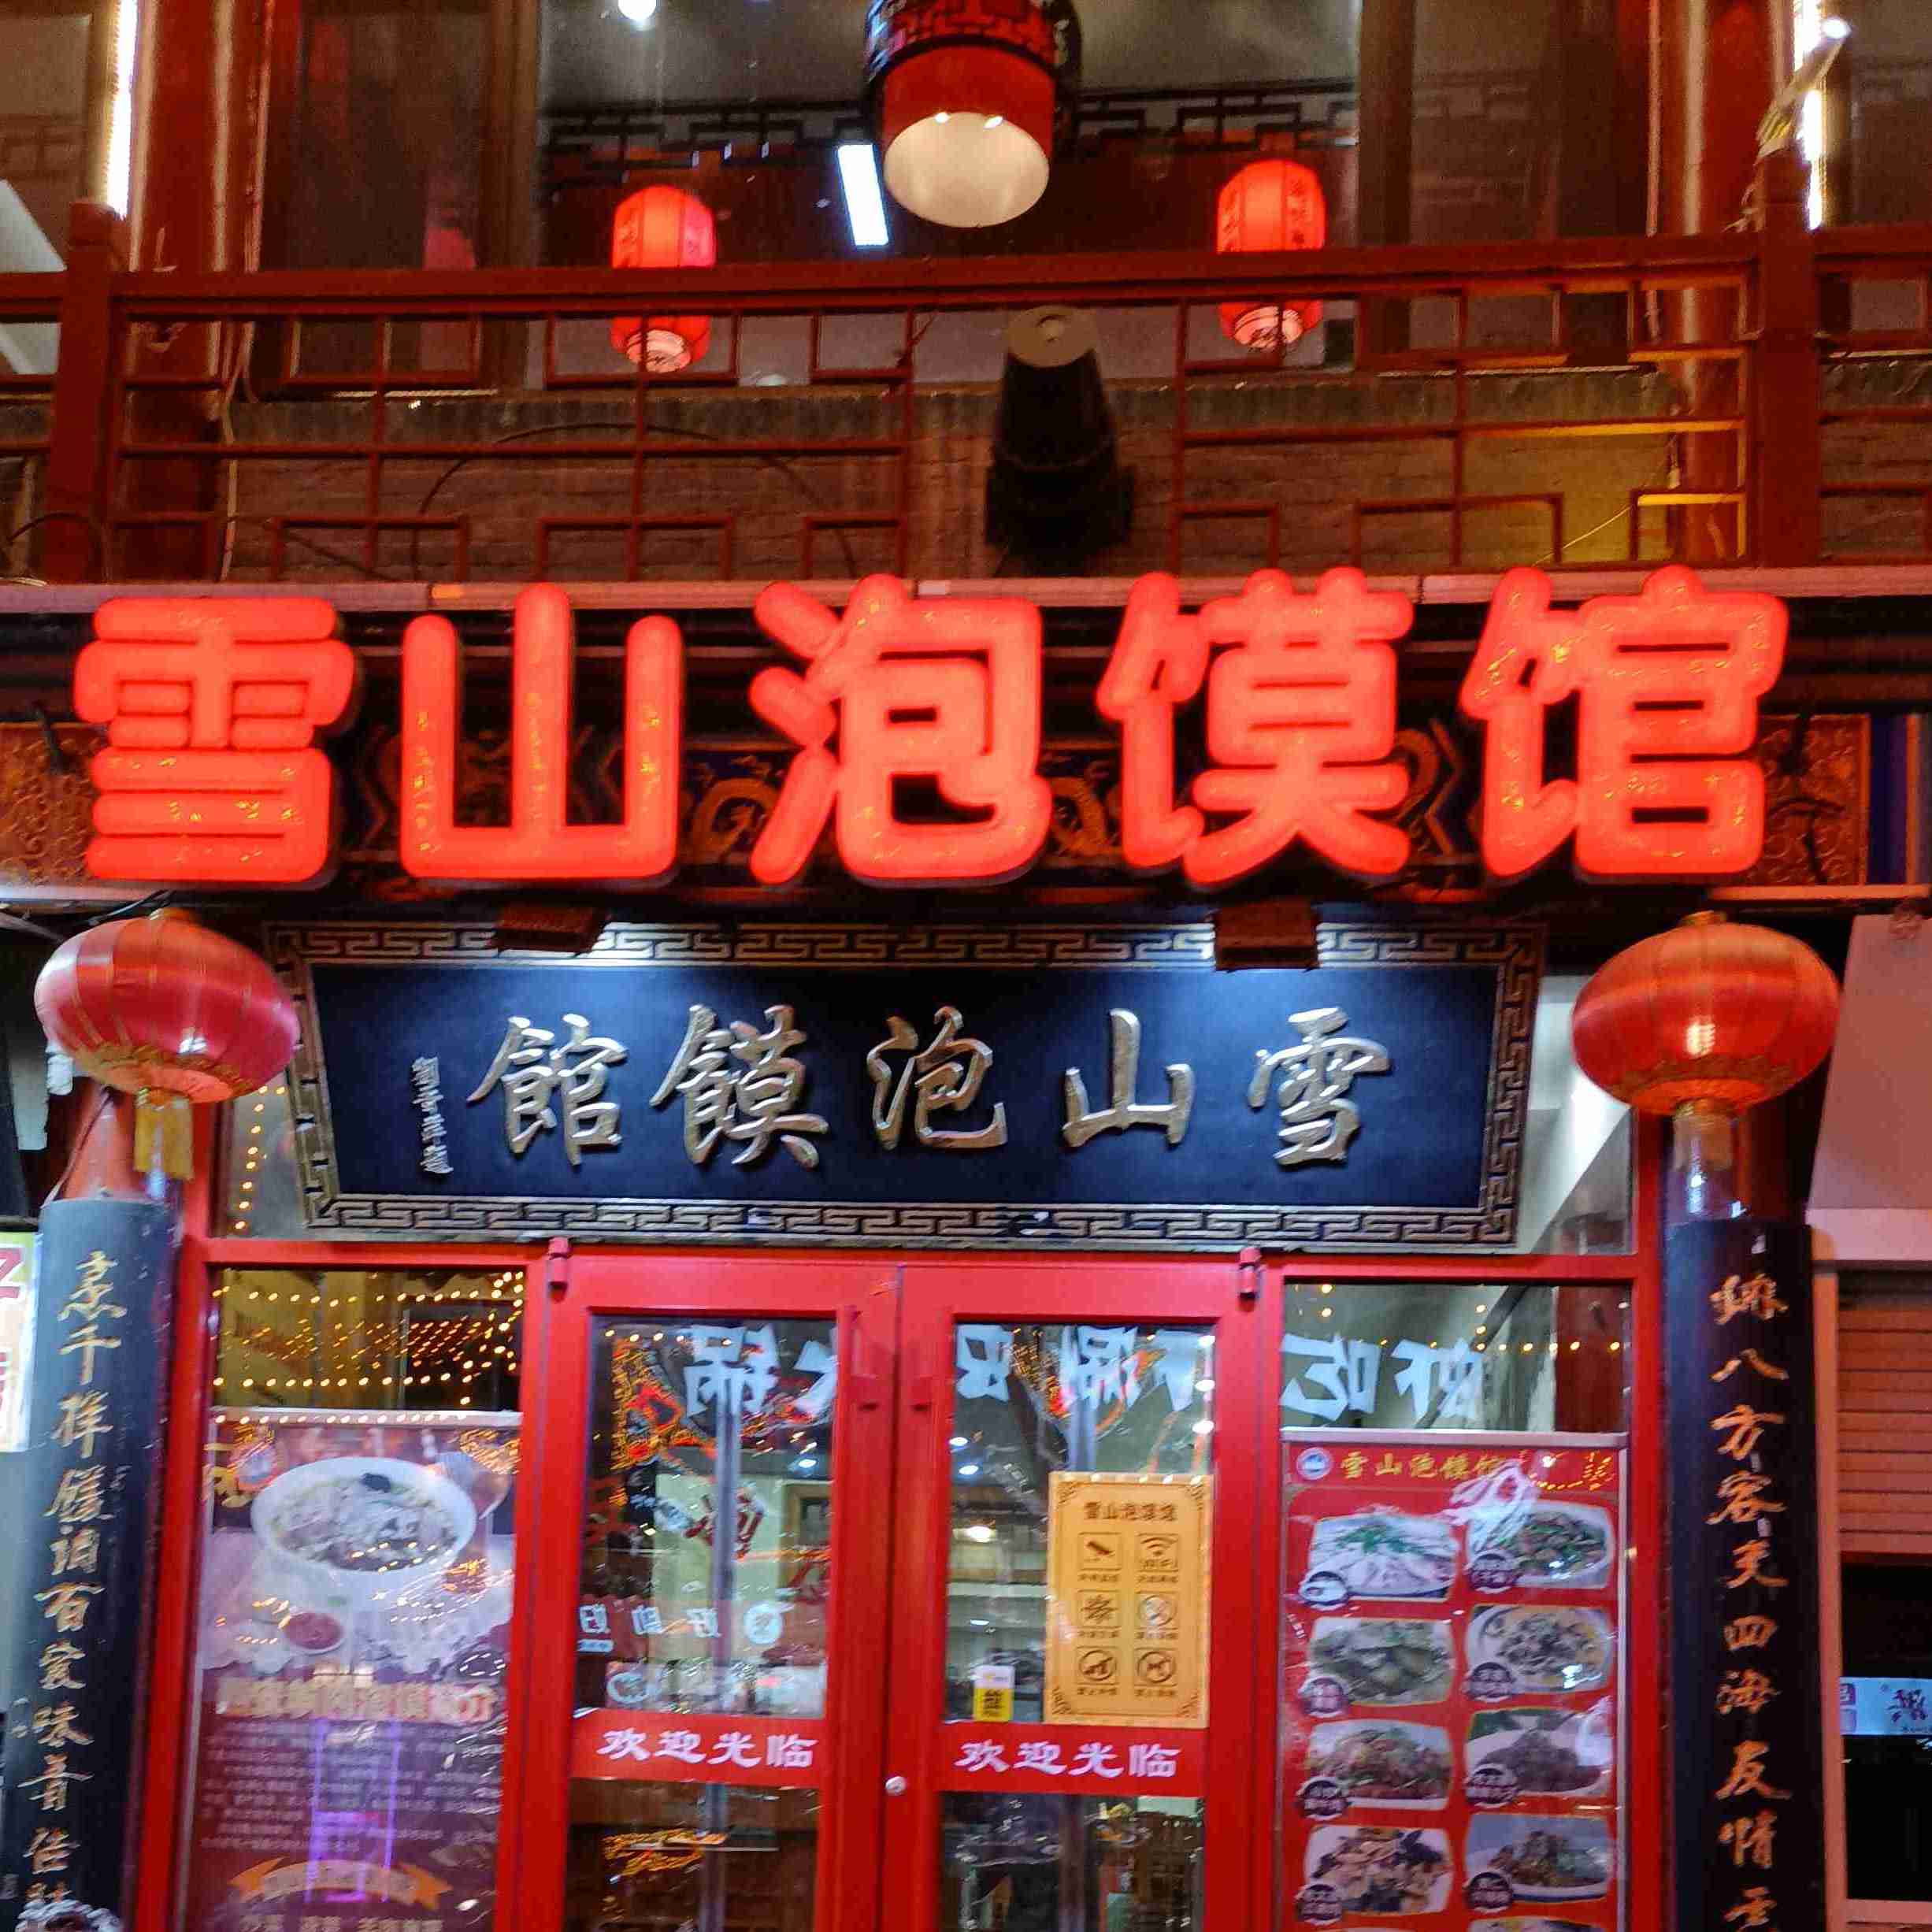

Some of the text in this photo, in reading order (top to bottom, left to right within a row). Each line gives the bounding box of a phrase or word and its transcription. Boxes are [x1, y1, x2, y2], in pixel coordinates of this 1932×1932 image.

[74, 565, 1789, 886] 雪山泡馍馆
[596, 1727, 819, 1768] 欢迎光临
[954, 1739, 1181, 1778] 欢迎光临
